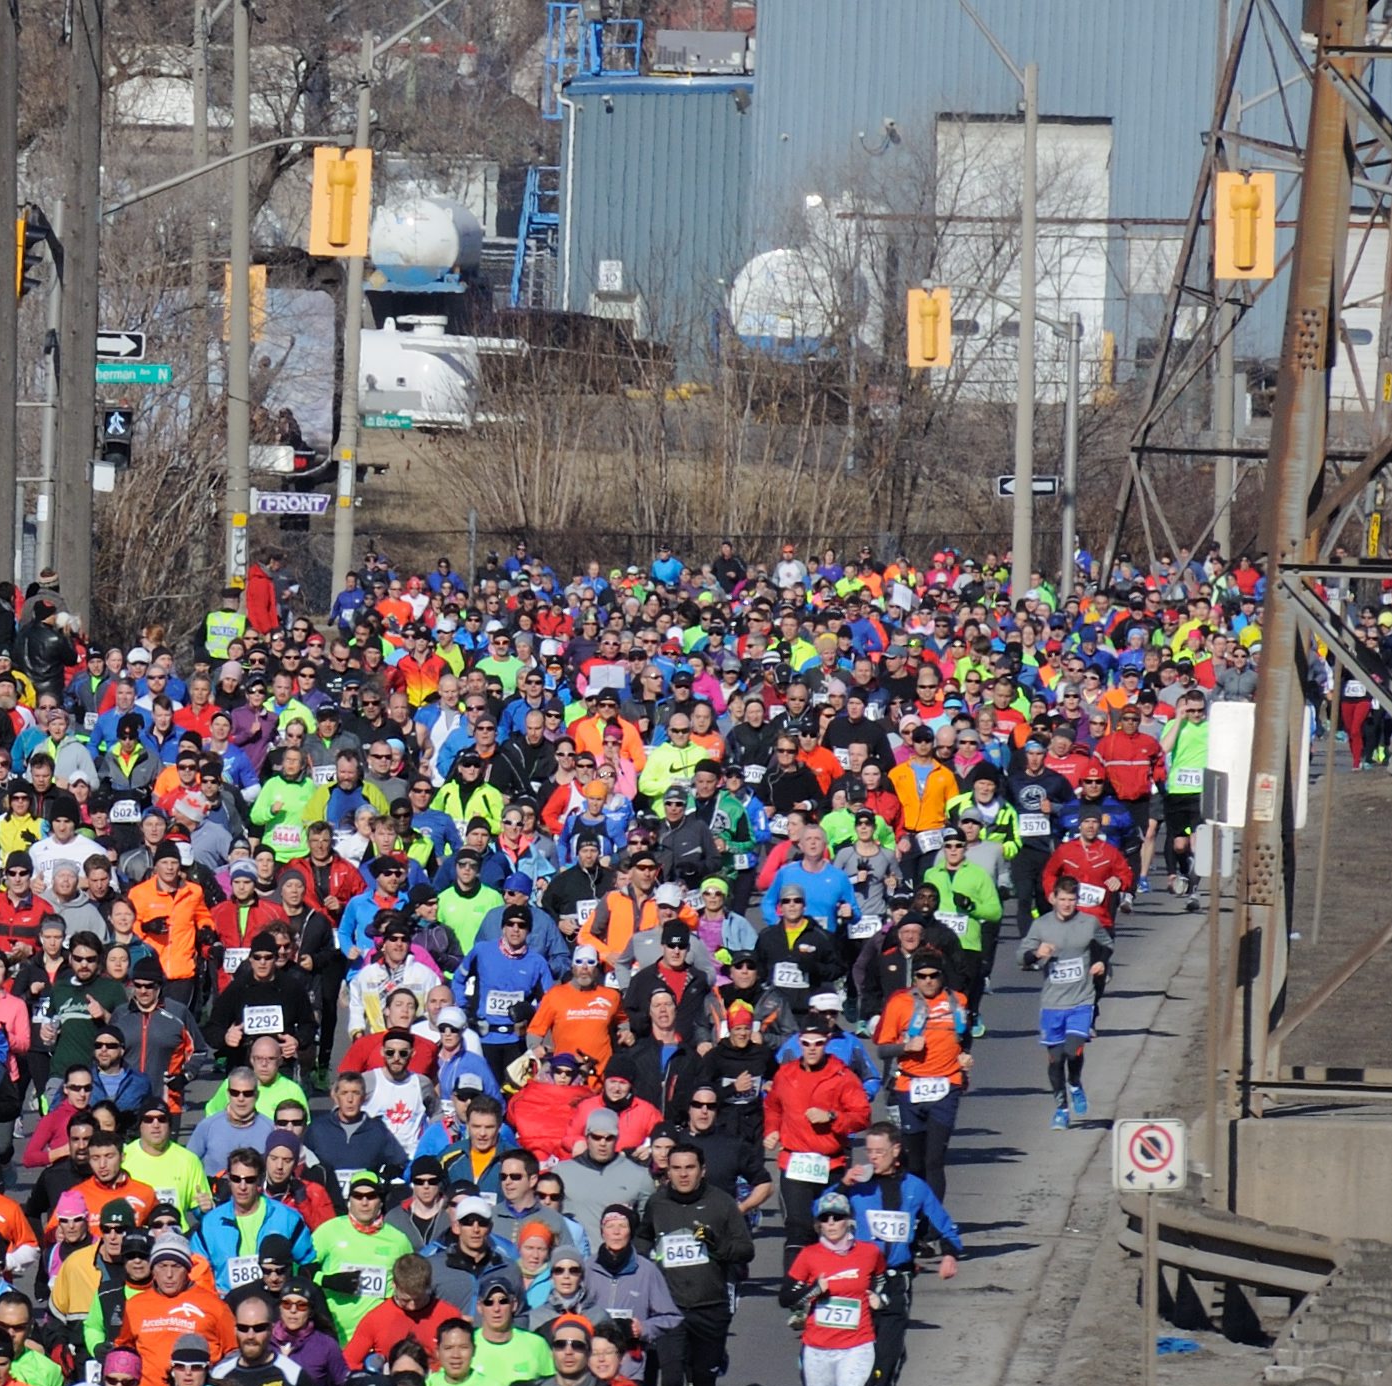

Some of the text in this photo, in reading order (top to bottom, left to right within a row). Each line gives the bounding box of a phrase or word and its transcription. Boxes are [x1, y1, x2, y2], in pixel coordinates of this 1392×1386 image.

[158, 368, 168, 380] N
[265, 494, 326, 512] FRONT
[1022, 821, 1047, 831] 3570
[247, 1014, 279, 1029] 2292
[667, 1242, 706, 1262] 6467
[232, 1266, 260, 1283] 588
[825, 1307, 855, 1322] 757
